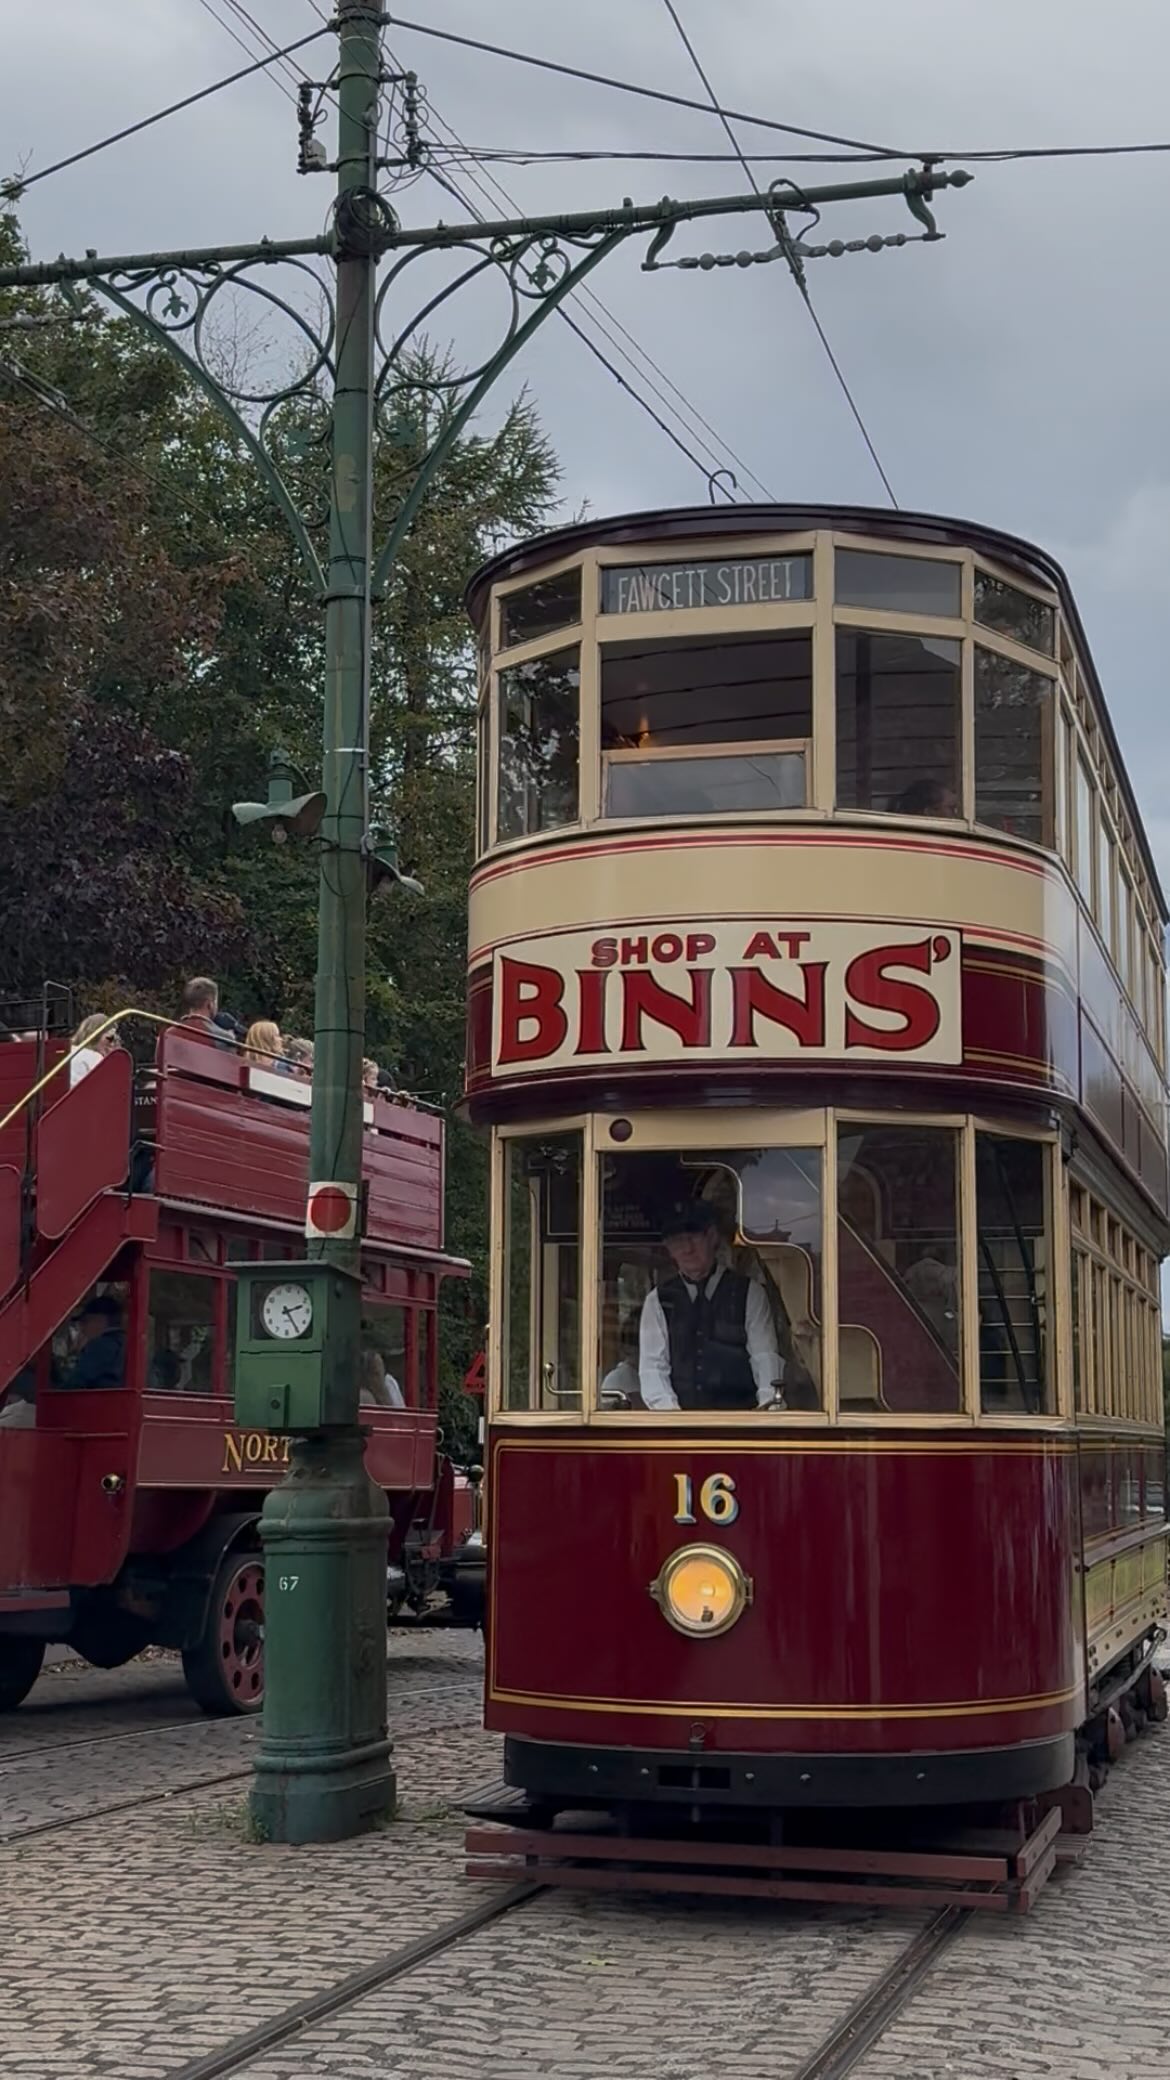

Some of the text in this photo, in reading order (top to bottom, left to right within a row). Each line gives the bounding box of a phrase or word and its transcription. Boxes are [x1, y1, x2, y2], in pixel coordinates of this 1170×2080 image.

[618, 561, 793, 613] FAWCETT STREET
[591, 932, 811, 967] SHOP AT
[496, 935, 952, 1066] BINNS'
[221, 1433, 290, 1472] NORT
[673, 1473, 739, 1525] 16
